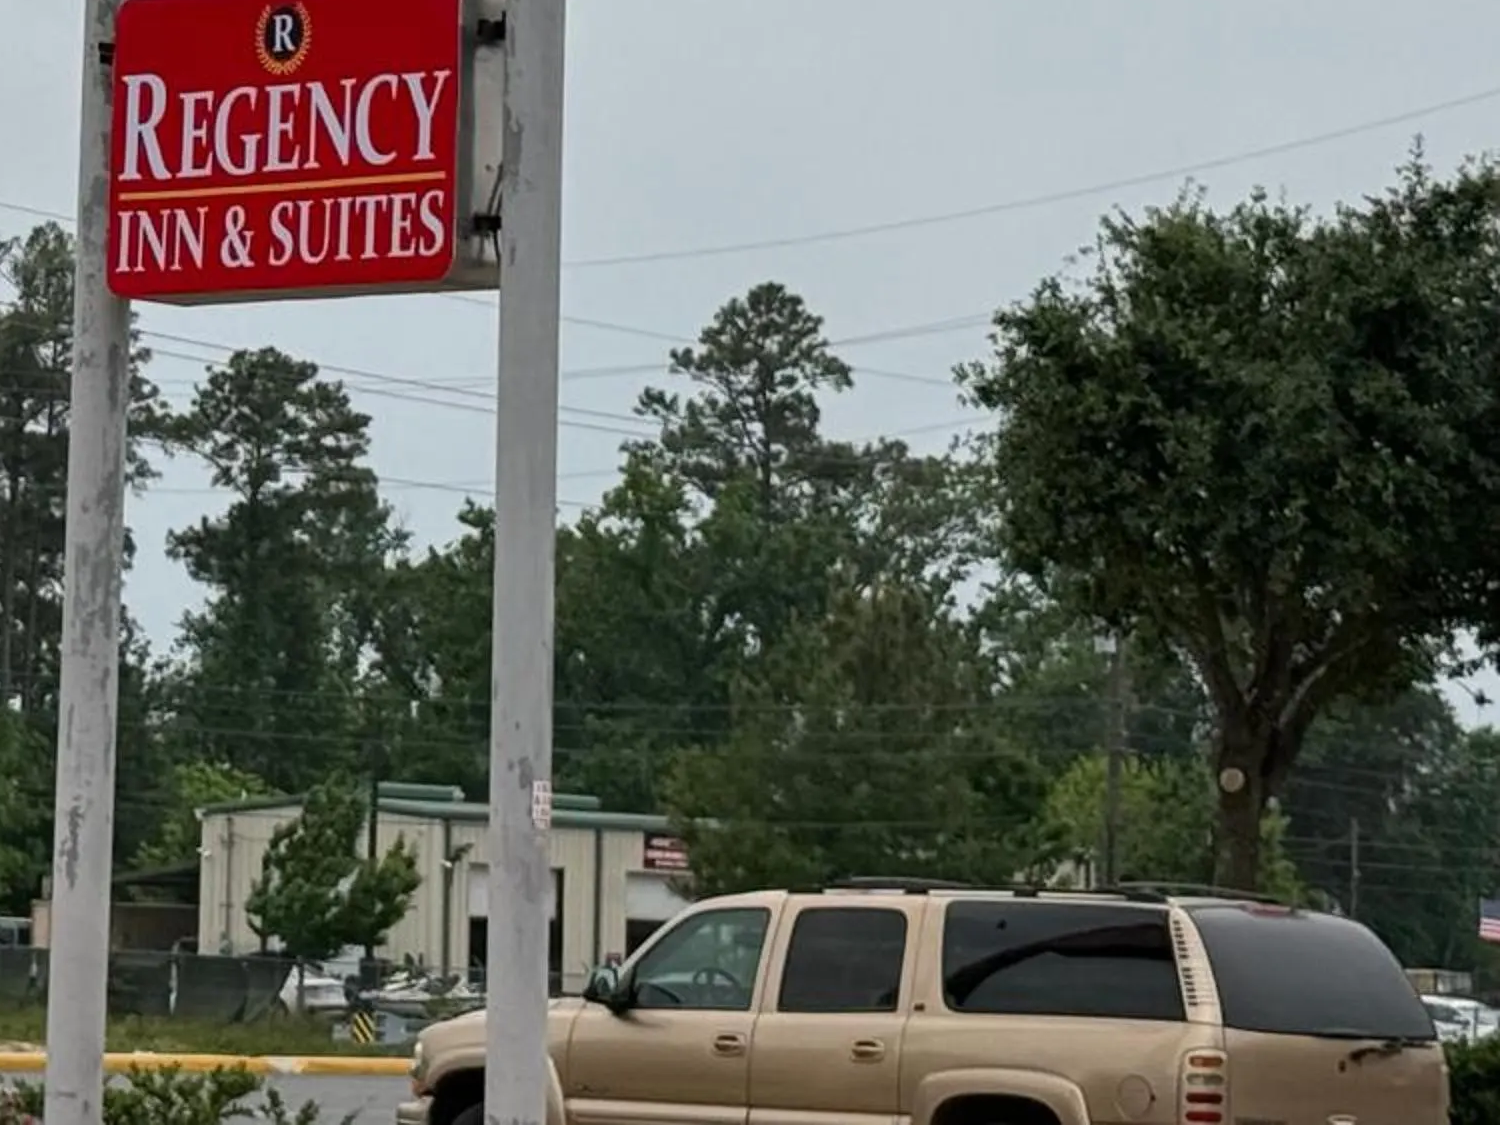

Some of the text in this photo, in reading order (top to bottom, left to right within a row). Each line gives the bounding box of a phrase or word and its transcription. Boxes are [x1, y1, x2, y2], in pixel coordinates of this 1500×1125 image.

[272, 13, 297, 54] R
[117, 69, 452, 182] REGENCY
[115, 189, 445, 273] INN & SUITES
